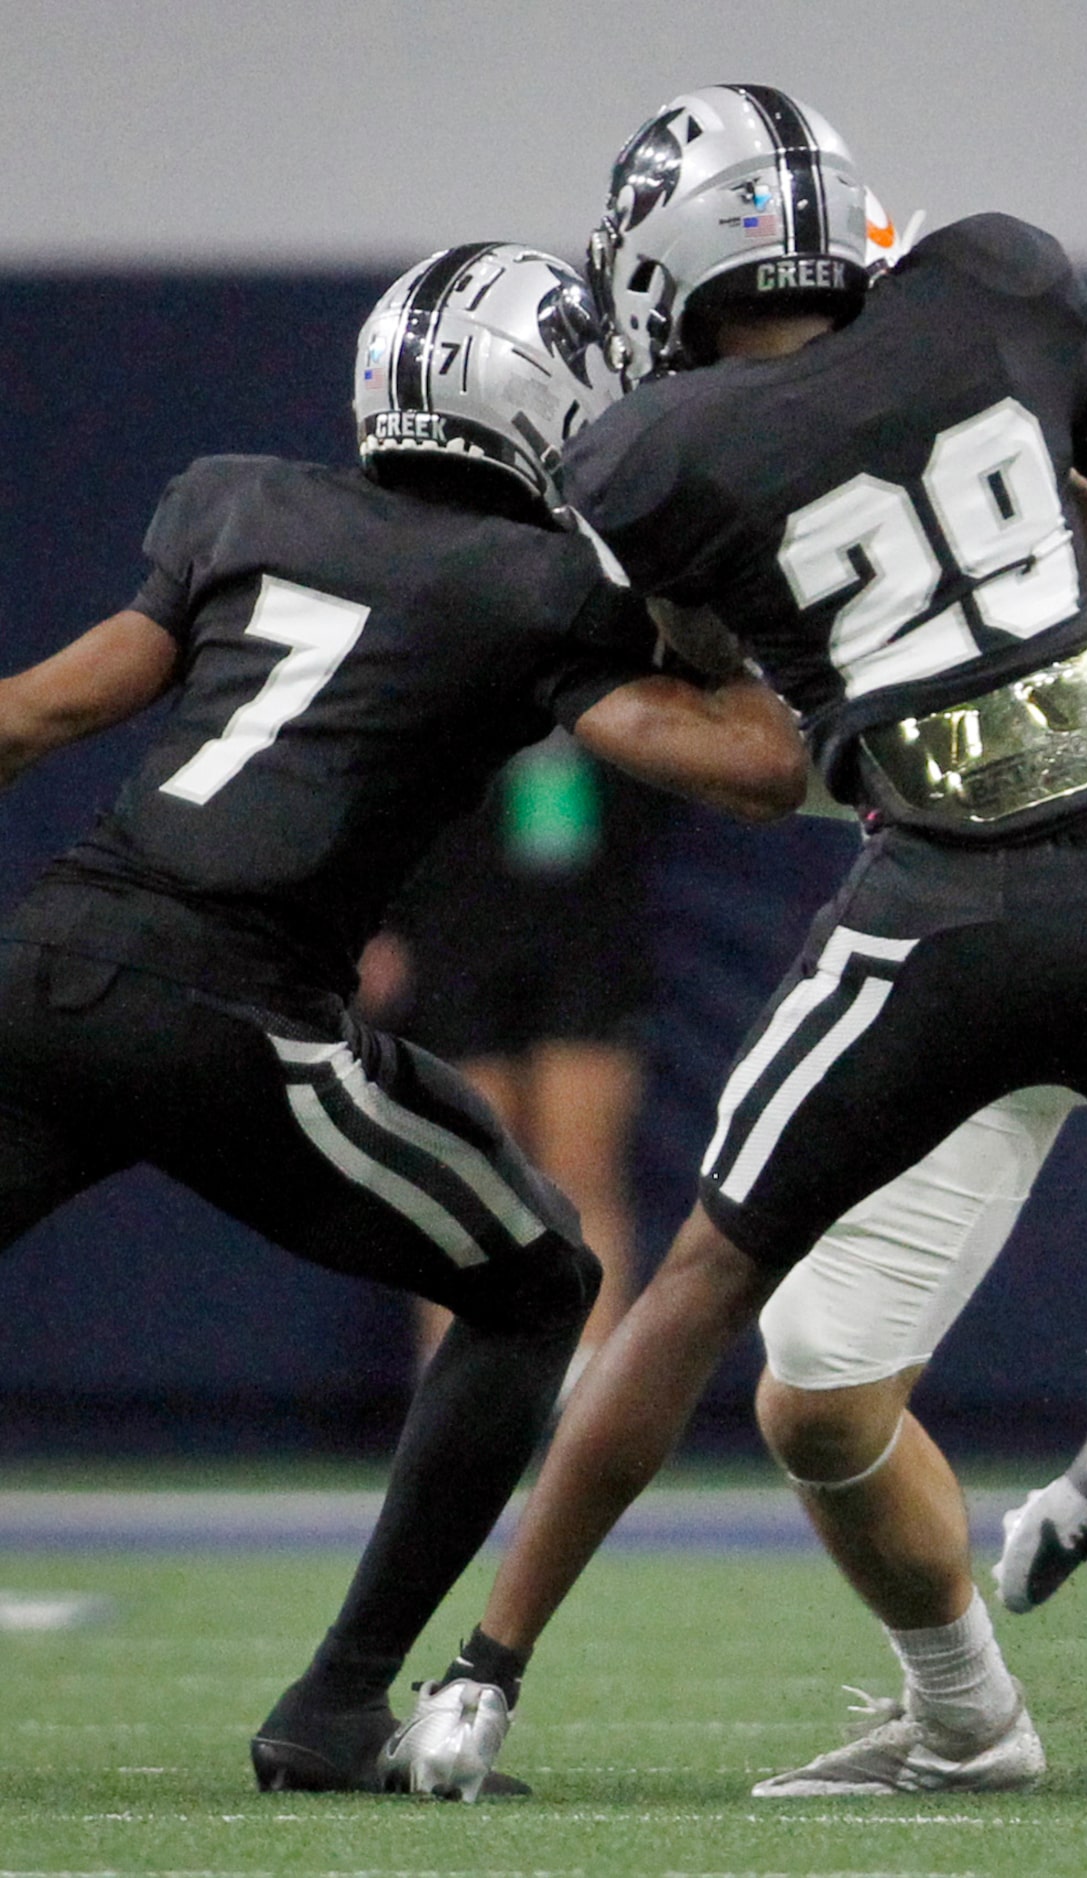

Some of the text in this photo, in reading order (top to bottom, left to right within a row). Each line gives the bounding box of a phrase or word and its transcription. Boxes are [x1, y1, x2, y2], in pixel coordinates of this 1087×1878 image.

[757, 259, 846, 293] CREEK
[439, 341, 462, 375] 7
[375, 412, 448, 441] CREEK
[777, 397, 1082, 700] 29
[159, 574, 372, 806] 7
